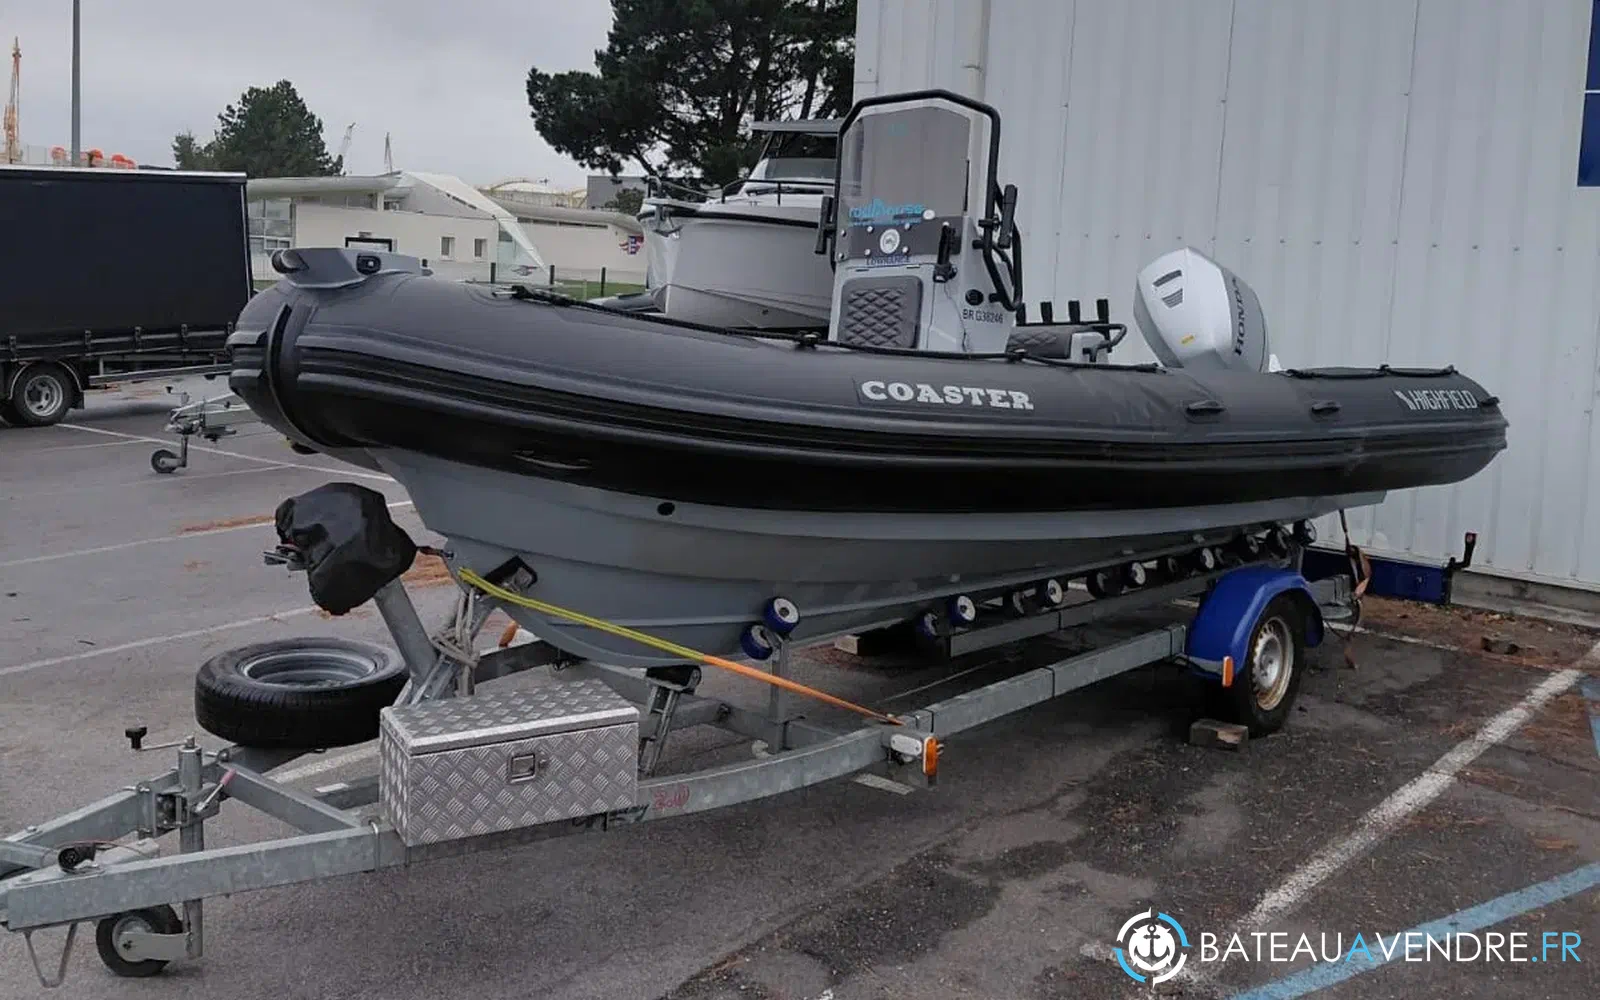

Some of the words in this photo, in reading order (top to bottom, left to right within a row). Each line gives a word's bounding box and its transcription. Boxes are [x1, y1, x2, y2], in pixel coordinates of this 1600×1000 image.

[962, 309, 974, 320] BR
[1231, 277, 1245, 356] HONDA
[861, 380, 1034, 410] COASTER
[1407, 389, 1478, 410] HIGHFIELD
